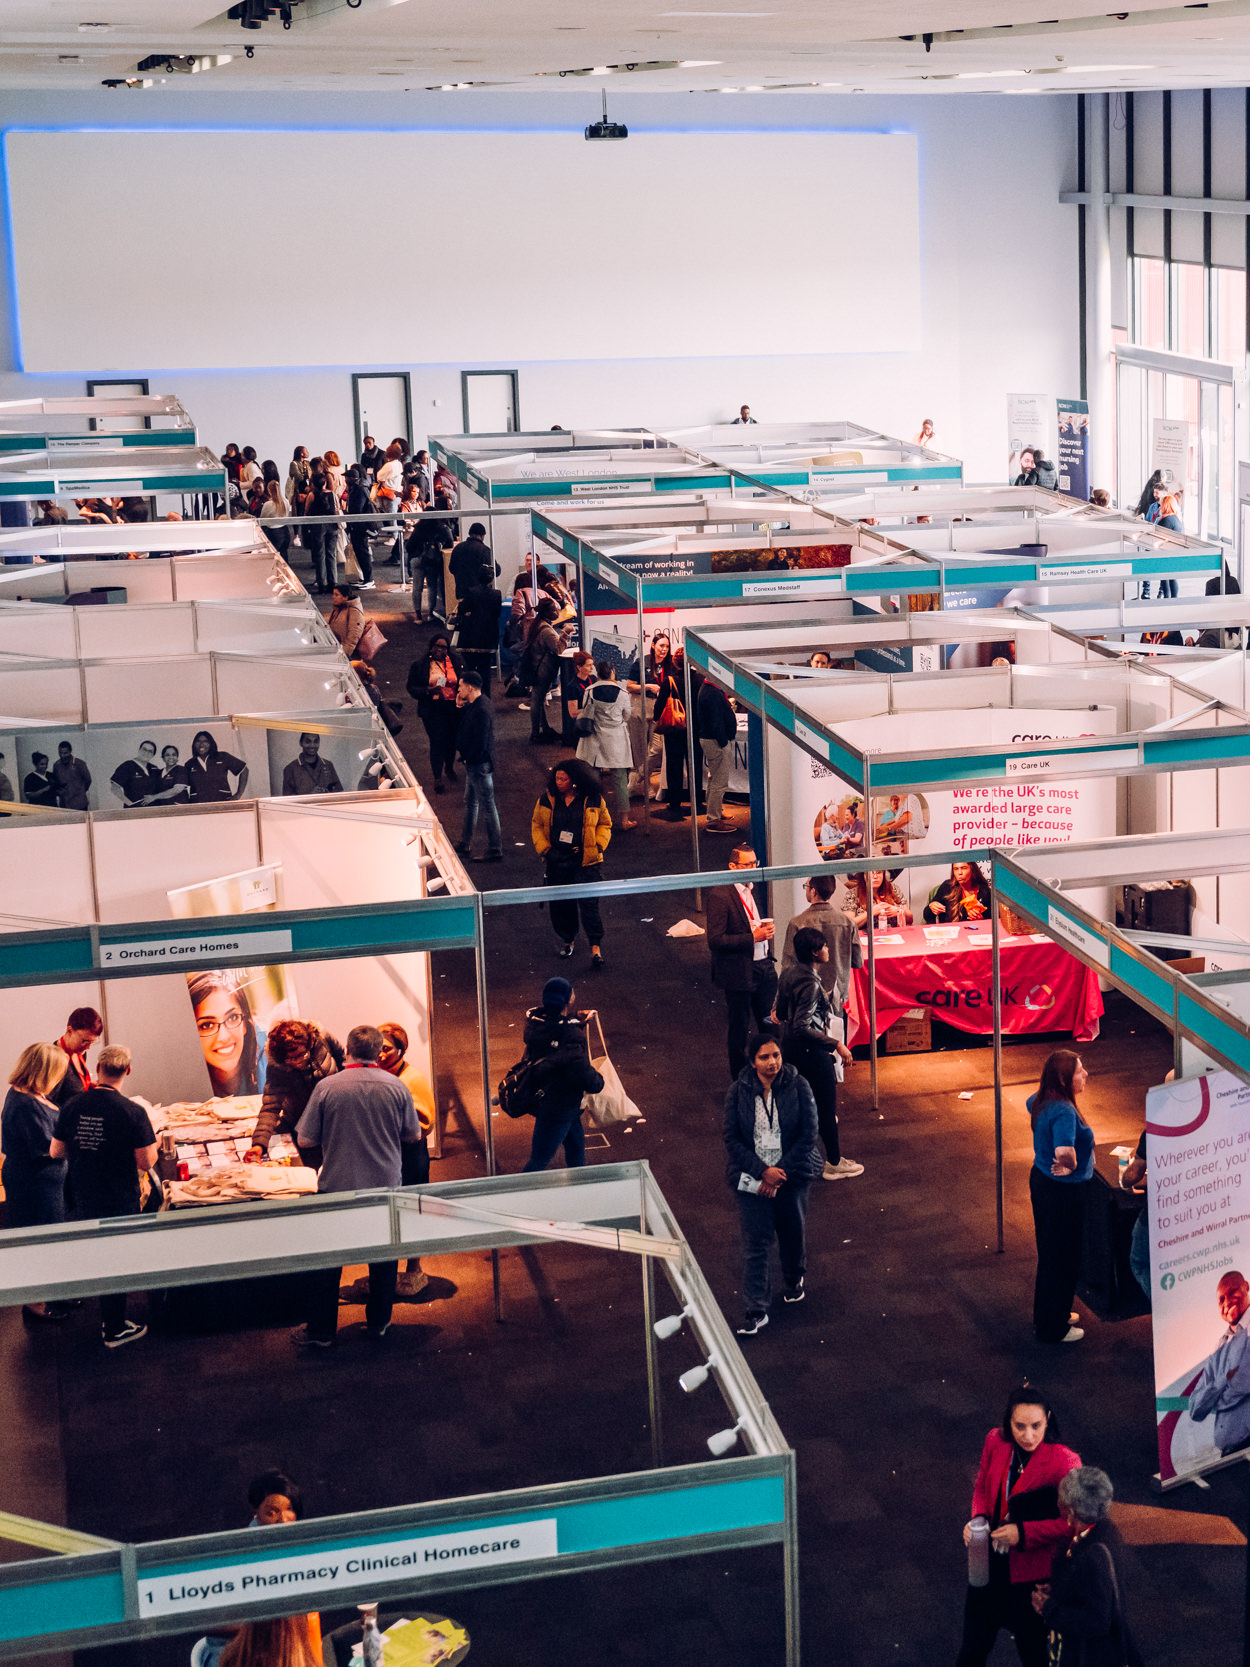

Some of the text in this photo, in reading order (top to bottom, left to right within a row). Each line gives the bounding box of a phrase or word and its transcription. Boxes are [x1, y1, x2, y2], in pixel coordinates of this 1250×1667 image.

[1059, 437, 1081, 446] Discover
[1059, 447, 1071, 455] your
[1059, 455, 1079, 464] nursing
[521, 469, 536, 478] We
[539, 470, 553, 478] are
[556, 468, 579, 477] West
[621, 561, 643, 569] ream
[644, 560, 653, 569] of
[654, 560, 685, 570] working
[1049, 569, 1069, 577] Ramsay
[959, 597, 977, 606] care
[1020, 762, 1038, 770] Care
[953, 785, 1079, 800] Were the UK's most
[952, 801, 1072, 817] awarded large care
[953, 817, 1074, 834] provider because
[953, 833, 968, 849] of
[969, 833, 1014, 849] people
[1017, 833, 1041, 846] like
[105, 941, 240, 960] 2 Orchard Care Homes
[915, 986, 1019, 1008] care UK
[1216, 1088, 1239, 1100] Cheshire
[1154, 1142, 1210, 1170] Wherever
[1212, 1134, 1234, 1154] you
[1155, 1170, 1184, 1194] your
[1185, 1159, 1222, 1181] career,
[1156, 1172, 1243, 1210] find something
[1157, 1194, 1232, 1230] to suit you at
[145, 1536, 522, 1605] 1 Lloyds Pharmacy Clinical Homecare
